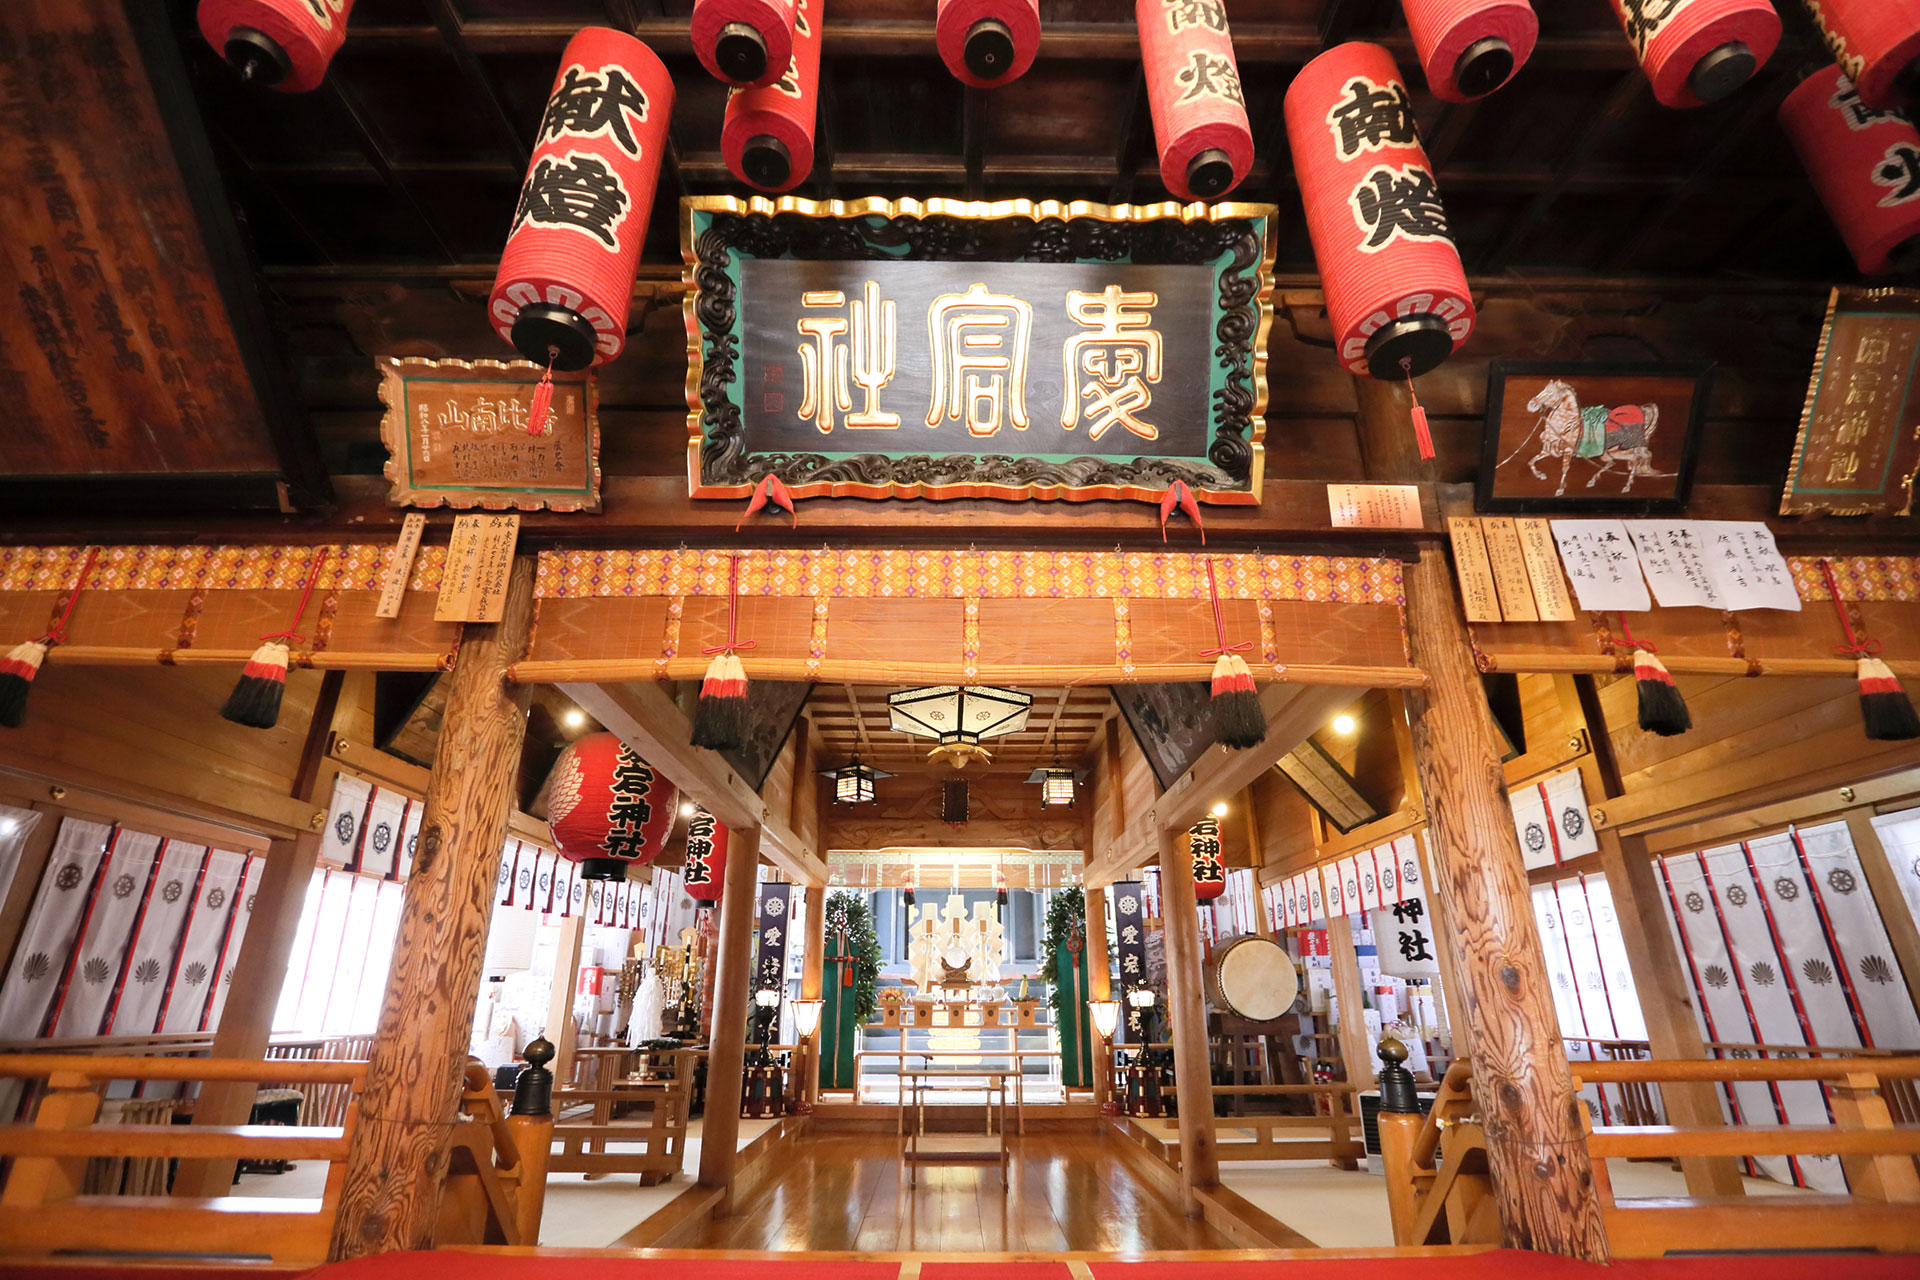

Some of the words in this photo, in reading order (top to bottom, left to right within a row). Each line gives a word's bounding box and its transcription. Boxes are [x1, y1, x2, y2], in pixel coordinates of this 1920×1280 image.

[507, 64, 649, 253] 献燈
[1326, 76, 1459, 254] 献燈
[684, 802, 717, 886] 宕神社
[1392, 897, 1434, 962] 神社
